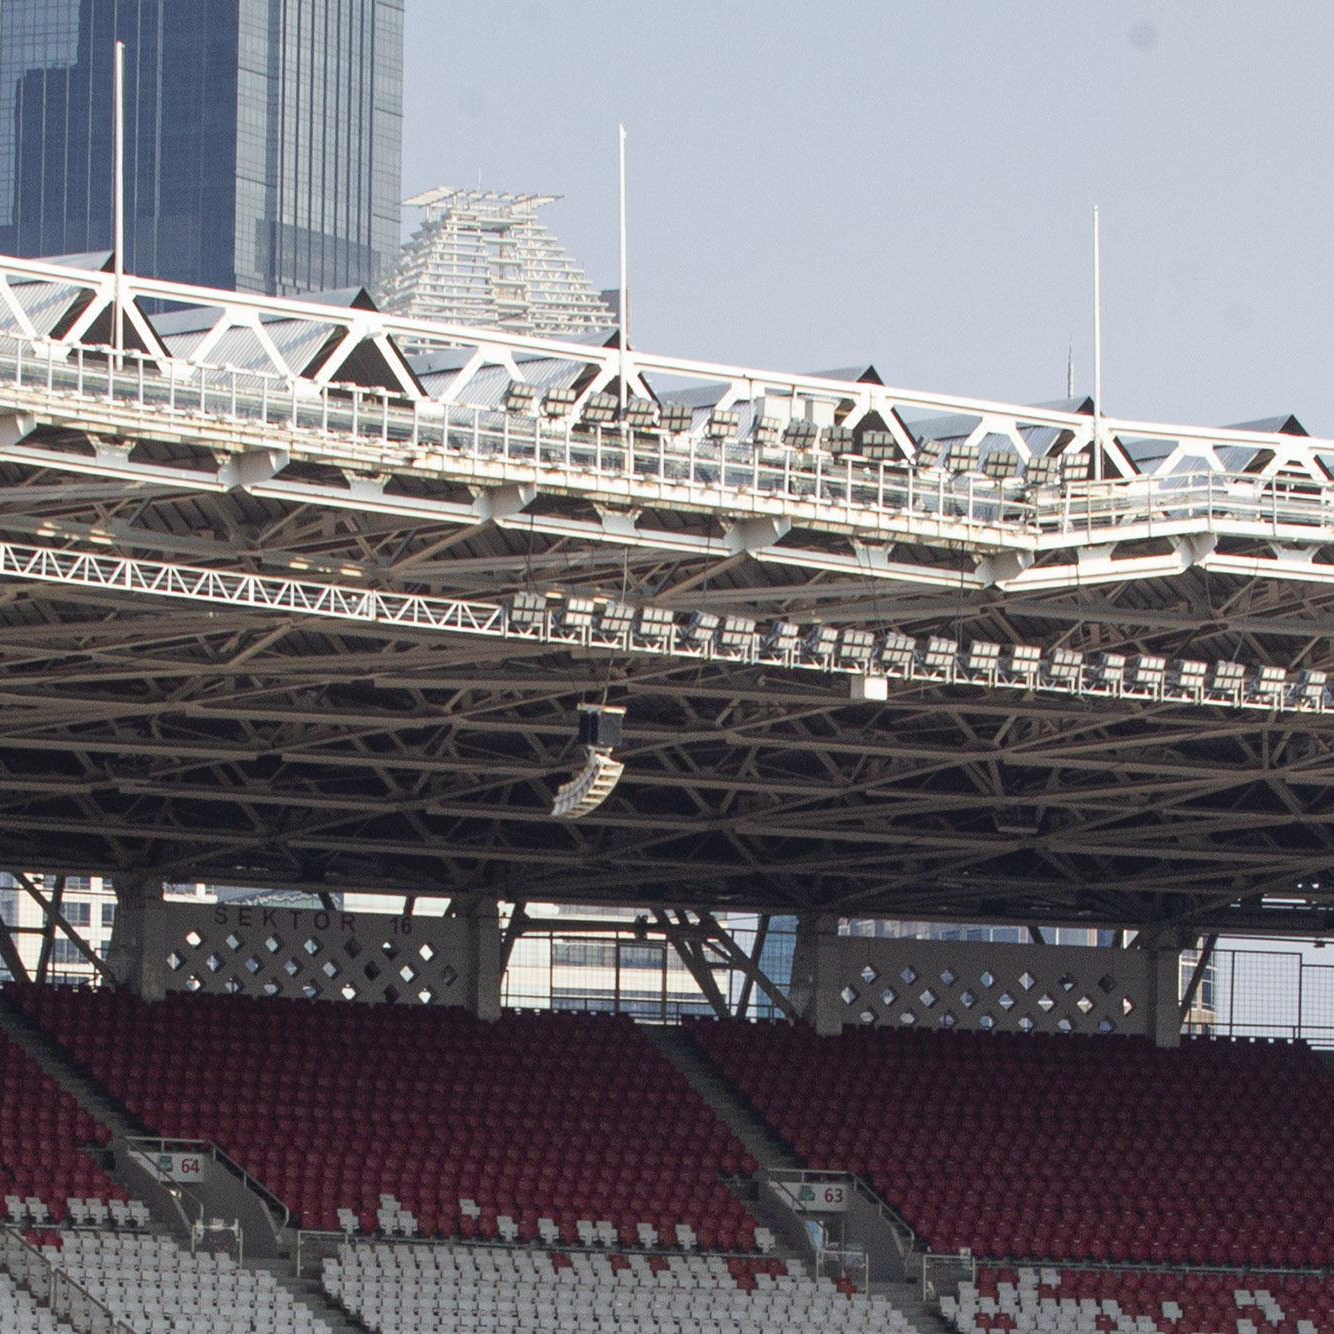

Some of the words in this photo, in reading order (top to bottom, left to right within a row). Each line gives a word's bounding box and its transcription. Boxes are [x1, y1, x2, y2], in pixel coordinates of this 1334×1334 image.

[214, 906, 356, 931] SEKTOR
[390, 916, 412, 935] 16
[181, 1158, 200, 1174] 64
[824, 1188, 843, 1203] 63
